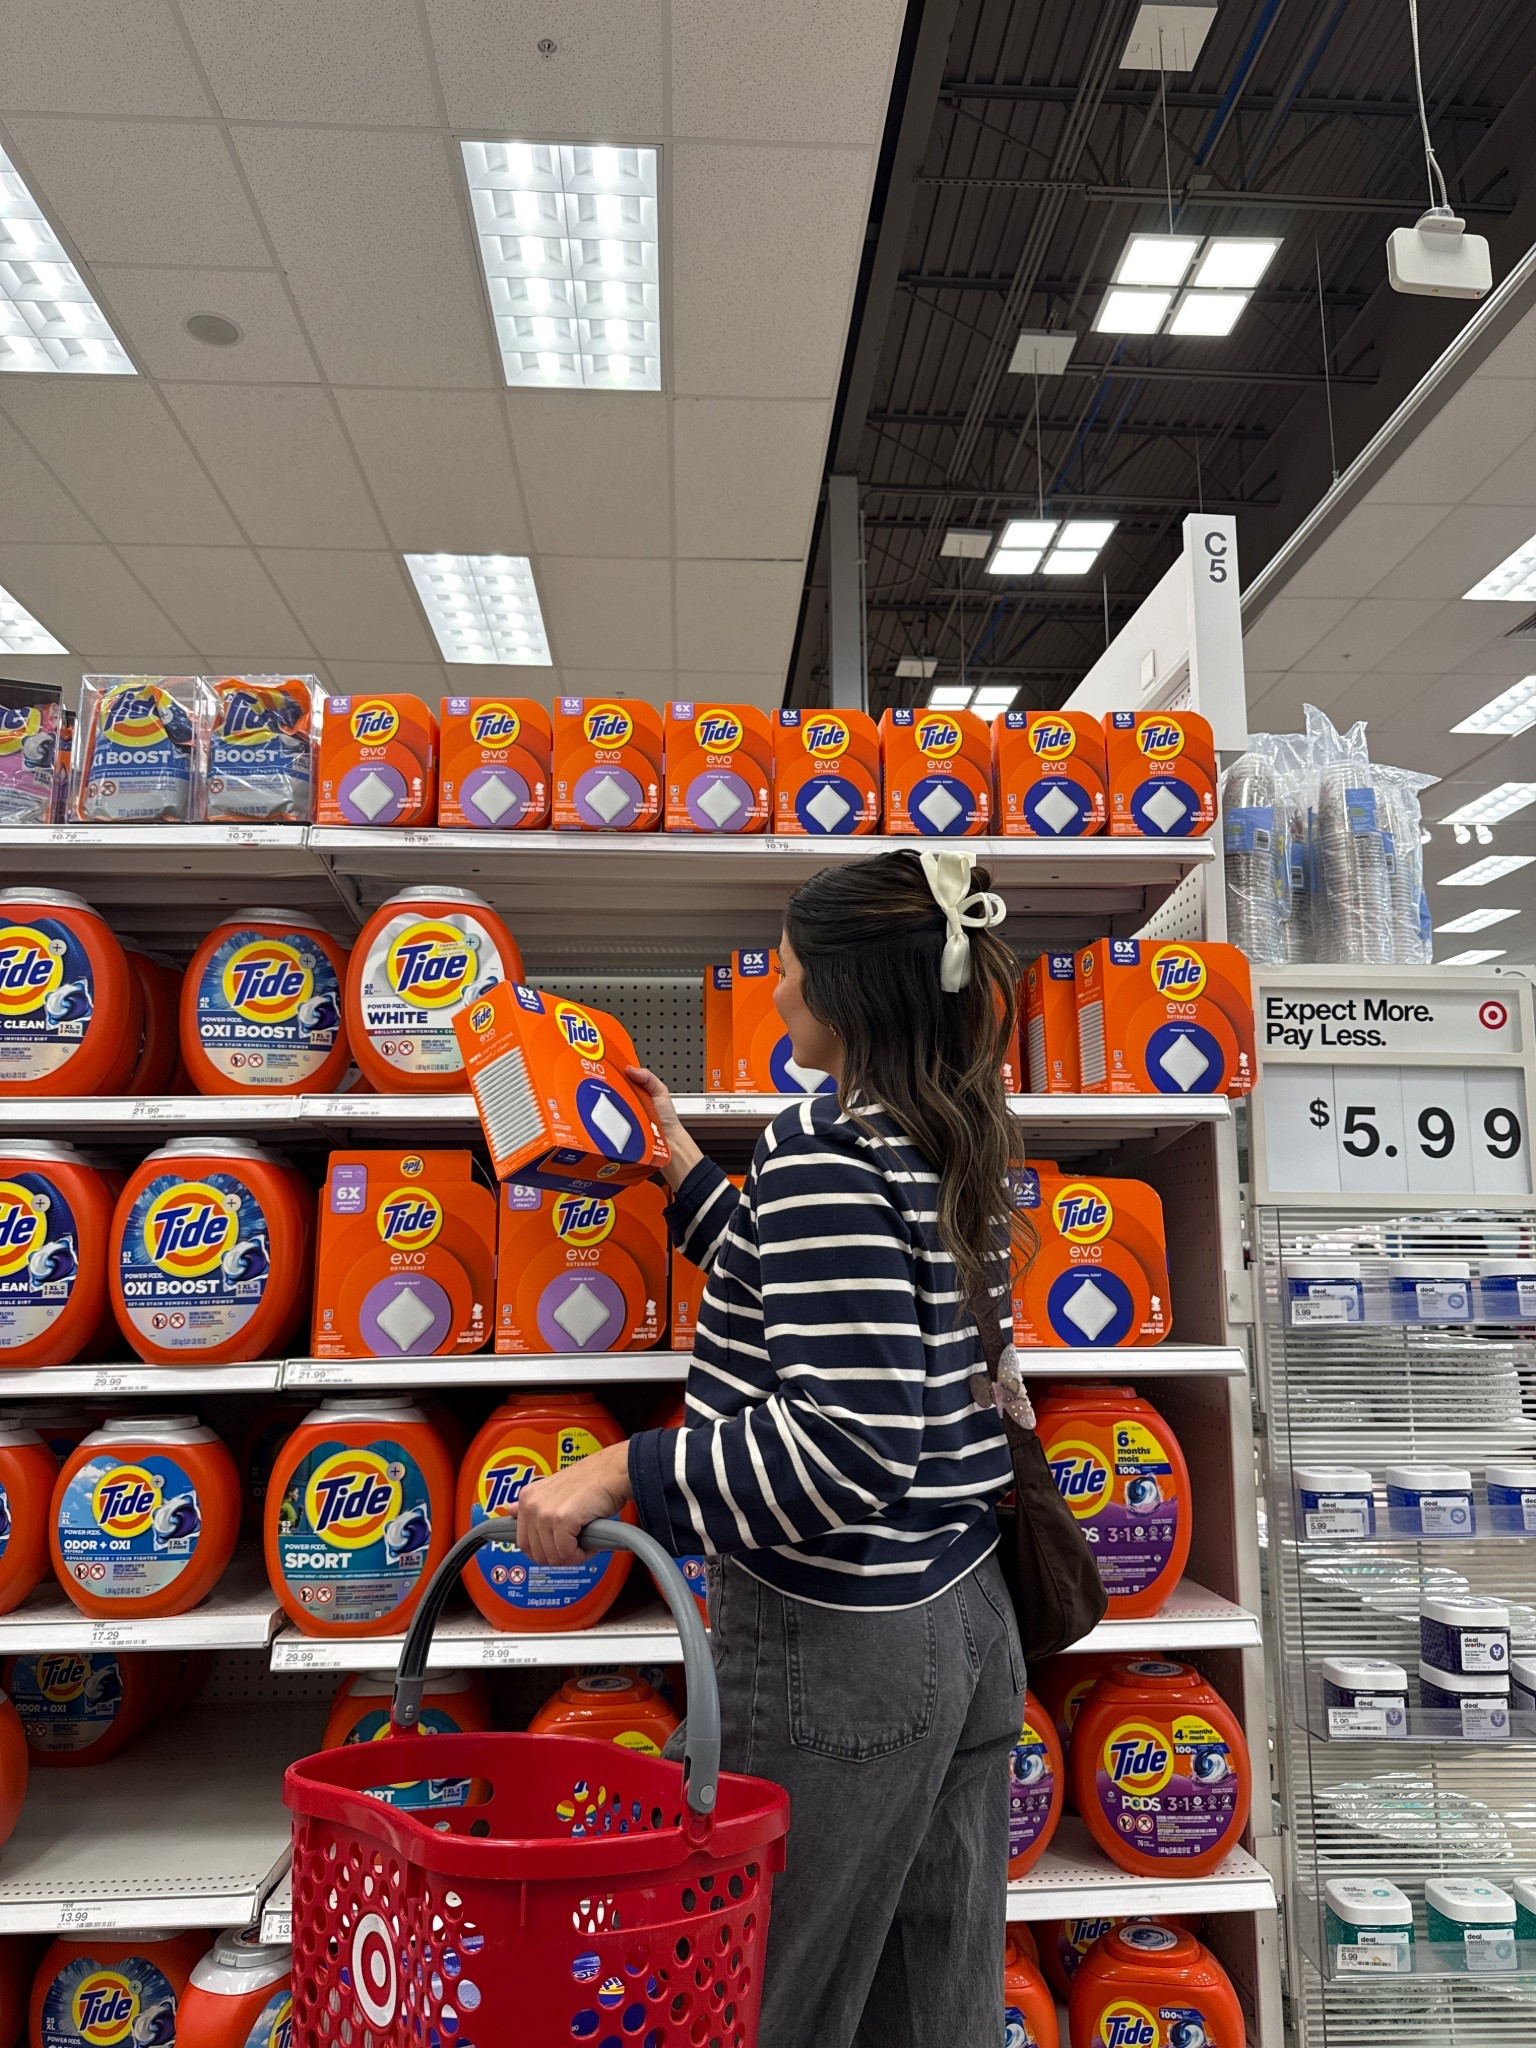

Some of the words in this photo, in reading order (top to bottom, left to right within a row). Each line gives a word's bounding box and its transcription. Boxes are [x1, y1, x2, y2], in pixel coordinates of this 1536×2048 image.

[1204, 531, 1227, 557] C
[1208, 558, 1227, 583] 5
[333, 698, 347, 707] 6X
[451, 699, 466, 708] 6X
[564, 699, 579, 708] 6X
[675, 704, 690, 713] 6X
[782, 710, 797, 719] 6X
[895, 710, 910, 719] 6X
[1008, 713, 1023, 721] 6X
[1116, 713, 1130, 721] 6X
[354, 711, 394, 739] Tide
[474, 714, 515, 742] Tide
[587, 714, 629, 742] Tide
[699, 720, 739, 747] Tide
[806, 725, 846, 752] Tide
[919, 724, 958, 752] Tide
[1141, 726, 1180, 754] Tide
[1033, 726, 1071, 755] Tide
[105, 750, 171, 765] BOOST
[214, 749, 278, 763] BOOST
[360, 747, 387, 756] evo
[481, 750, 508, 759] evo
[595, 750, 621, 759] evo
[706, 755, 732, 764] evo
[814, 760, 839, 770] evo
[927, 760, 953, 770] evo
[1041, 762, 1067, 771] evo
[1149, 762, 1175, 771] evo
[1113, 941, 1135, 954] 6X
[743, 953, 764, 965] 6X
[1052, 957, 1073, 969] 6X
[394, 943, 469, 994] Tide
[1156, 957, 1201, 992] Tide
[231, 960, 305, 1008] Tide
[517, 986, 536, 1001] 6X
[1166, 1002, 1196, 1015] evo
[1266, 997, 1356, 1025] Expect
[1364, 998, 1434, 1022] More.
[3, 1019, 45, 1030] CLEAN
[367, 1011, 428, 1025] WHITE
[471, 1006, 493, 1032] Tide
[200, 1024, 231, 1038] OXI
[234, 1025, 296, 1039] BOOST
[479, 1028, 496, 1043] evo
[558, 1013, 598, 1046] Tide
[1266, 1022, 1313, 1050] Pay
[1321, 1023, 1387, 1046] Less.
[580, 1058, 606, 1076] evo
[1240, 1068, 1250, 1076] 42
[132, 1107, 160, 1115] 21.99
[402, 1159, 422, 1173] Tide
[336, 1186, 361, 1200] 6X
[513, 1185, 536, 1197] 6X
[382, 1201, 437, 1241] Tide
[557, 1198, 610, 1238] Tide
[1058, 1197, 1107, 1235] Tide
[0, 1204, 37, 1247] de
[152, 1205, 229, 1263] Tide
[390, 1252, 426, 1265] evo
[566, 1249, 600, 1261] evo
[1069, 1246, 1102, 1258] evo
[124, 1282, 152, 1296] OXI
[155, 1280, 220, 1295] BOOST
[1152, 1313, 1163, 1321] 42
[1295, 1308, 1311, 1317] 5.99
[472, 1321, 484, 1329] 42
[645, 1317, 658, 1325] 42
[299, 1371, 326, 1379] 21.99
[94, 1378, 122, 1387] 29.99
[1117, 1447, 1151, 1455] months
[1117, 1455, 1140, 1463] mois
[1118, 1466, 1141, 1474] 100%
[1049, 1458, 1107, 1498] Tide
[483, 1465, 546, 1515] Tid
[98, 1483, 156, 1526] Tide
[313, 1473, 393, 1534] Tide
[1424, 1505, 1447, 1513] worthy
[1310, 1522, 1327, 1530] 5.99
[64, 1540, 97, 1550] ODOR
[109, 1540, 131, 1550] OXI
[284, 1552, 352, 1569] SPORT
[92, 1631, 119, 1641] 17.29
[286, 1652, 314, 1662] 29.99
[482, 1649, 510, 1658] 29.99
[41, 1658, 86, 1692] Tide
[15, 1704, 41, 1713] ODOR
[50, 1704, 67, 1713] OXI
[1174, 1746, 1197, 1754] 100%
[1109, 1740, 1168, 1783] Tide
[1121, 1795, 1162, 1812] PODS
[60, 1912, 88, 1922] 13.99
[1073, 1918, 1112, 1945] Tide
[1341, 1953, 1358, 1961] 5.99
[78, 1987, 133, 2034] Tide
[1160, 2010, 1183, 2020] 100%
[1105, 2015, 1154, 2048] Tide
